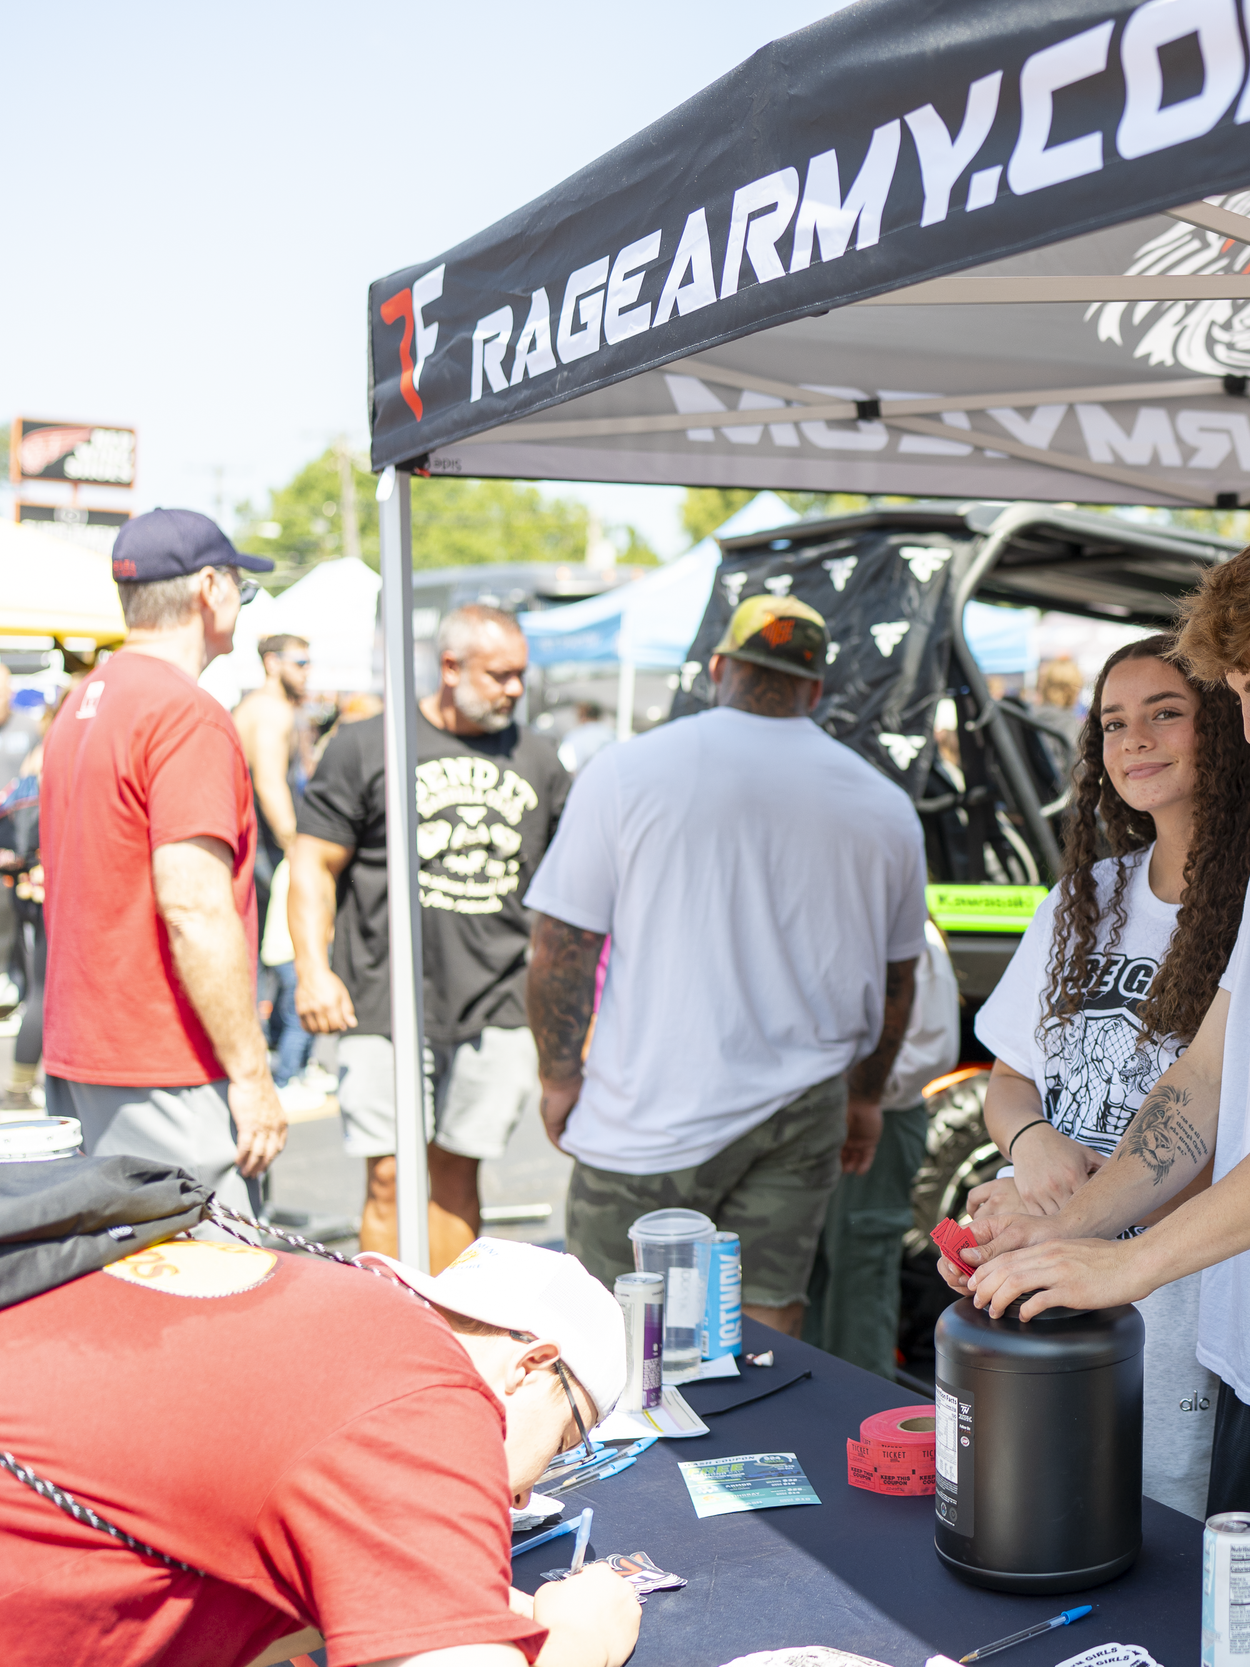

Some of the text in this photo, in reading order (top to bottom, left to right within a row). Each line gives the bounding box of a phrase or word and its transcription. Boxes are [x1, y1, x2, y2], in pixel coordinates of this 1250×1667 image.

[1179, 1389, 1211, 1411] alo
[852, 1444, 869, 1455] TICKET
[882, 1450, 906, 1458] TICKET
[922, 1450, 936, 1458] TIC
[687, 1463, 744, 1476] FREE
[851, 1466, 862, 1474] KEEP
[1085, 1647, 1118, 1661] GIRLS
[1096, 1655, 1130, 1666] GIRLS
